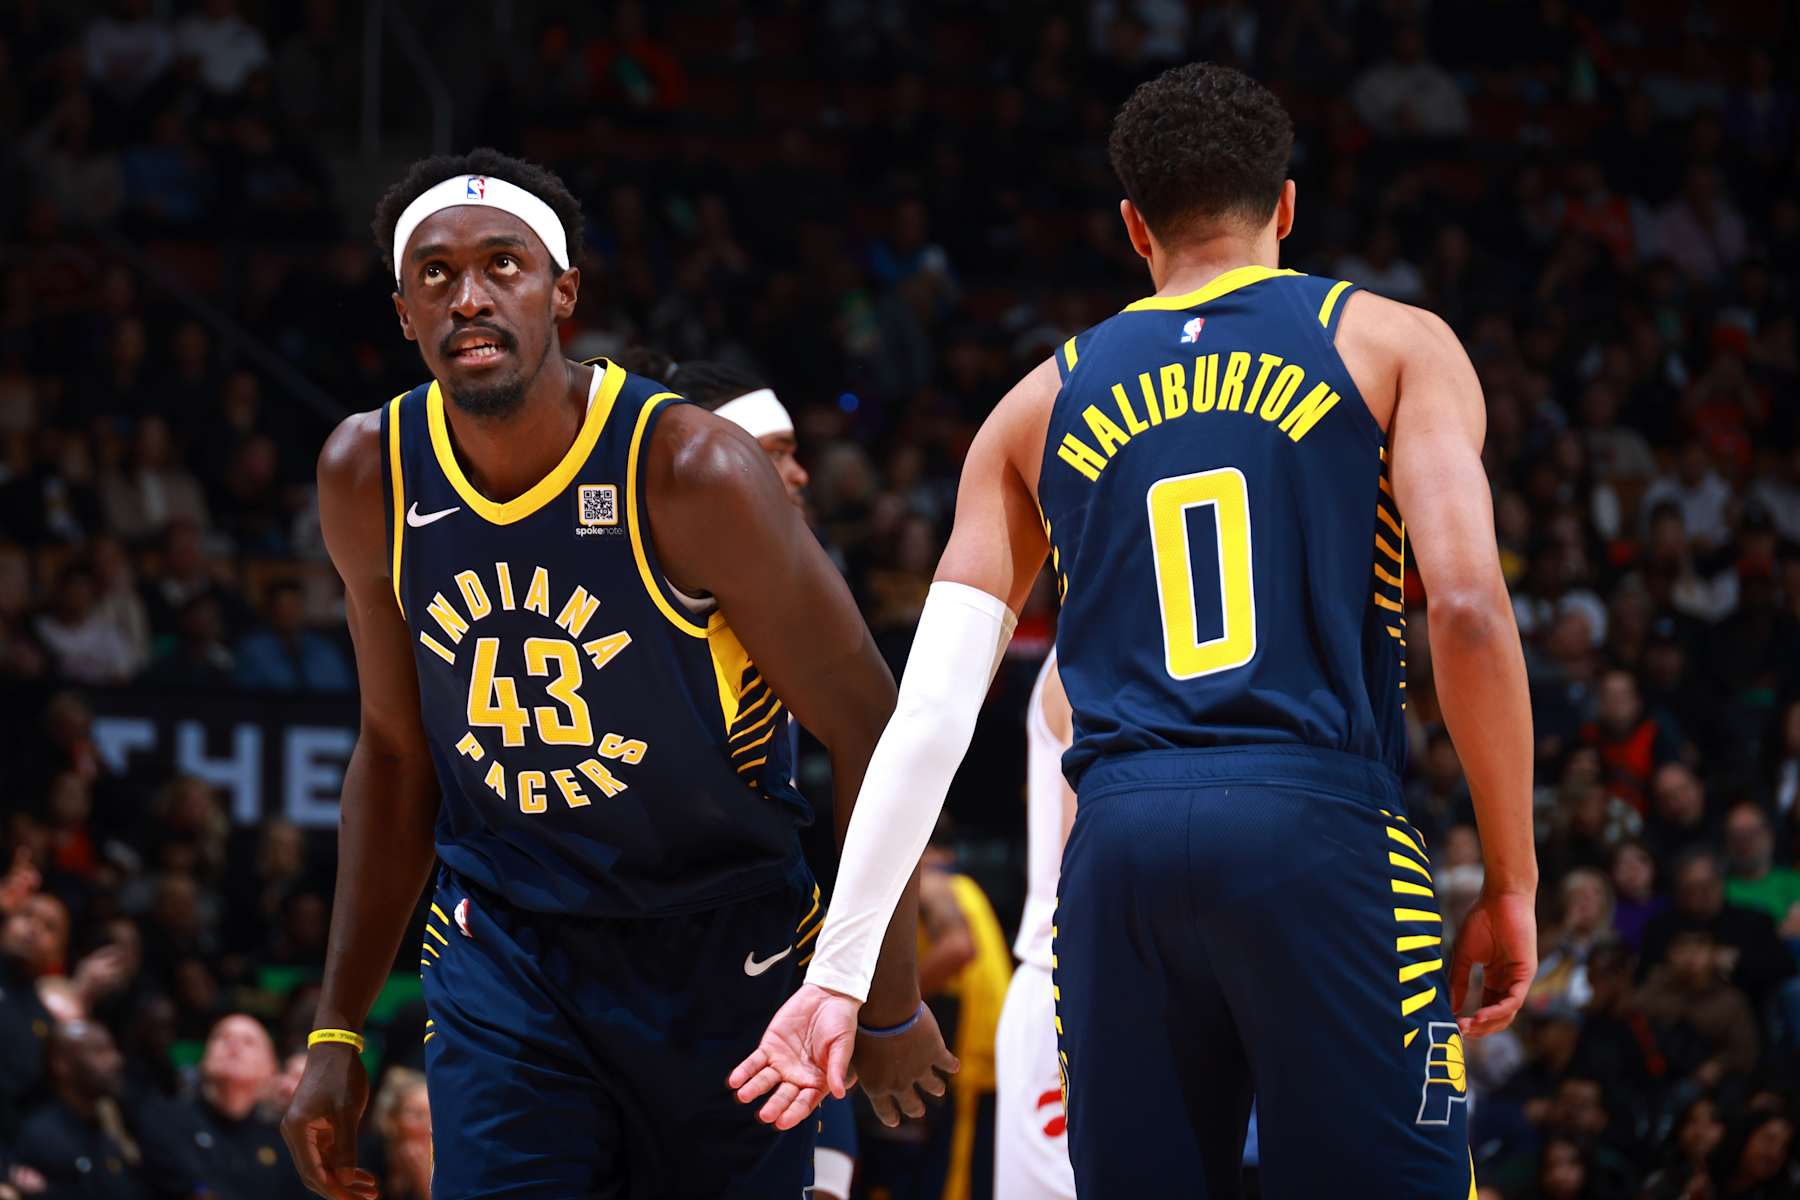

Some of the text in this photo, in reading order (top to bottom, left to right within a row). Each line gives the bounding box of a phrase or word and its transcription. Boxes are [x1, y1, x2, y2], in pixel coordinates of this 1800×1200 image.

[1057, 351, 1341, 482] HALIBURTON
[575, 525, 622, 537] spokenote
[1147, 467, 1256, 681] 0
[419, 561, 633, 670] INDIANA
[466, 637, 594, 747] 43
[455, 731, 648, 814] PACERS
